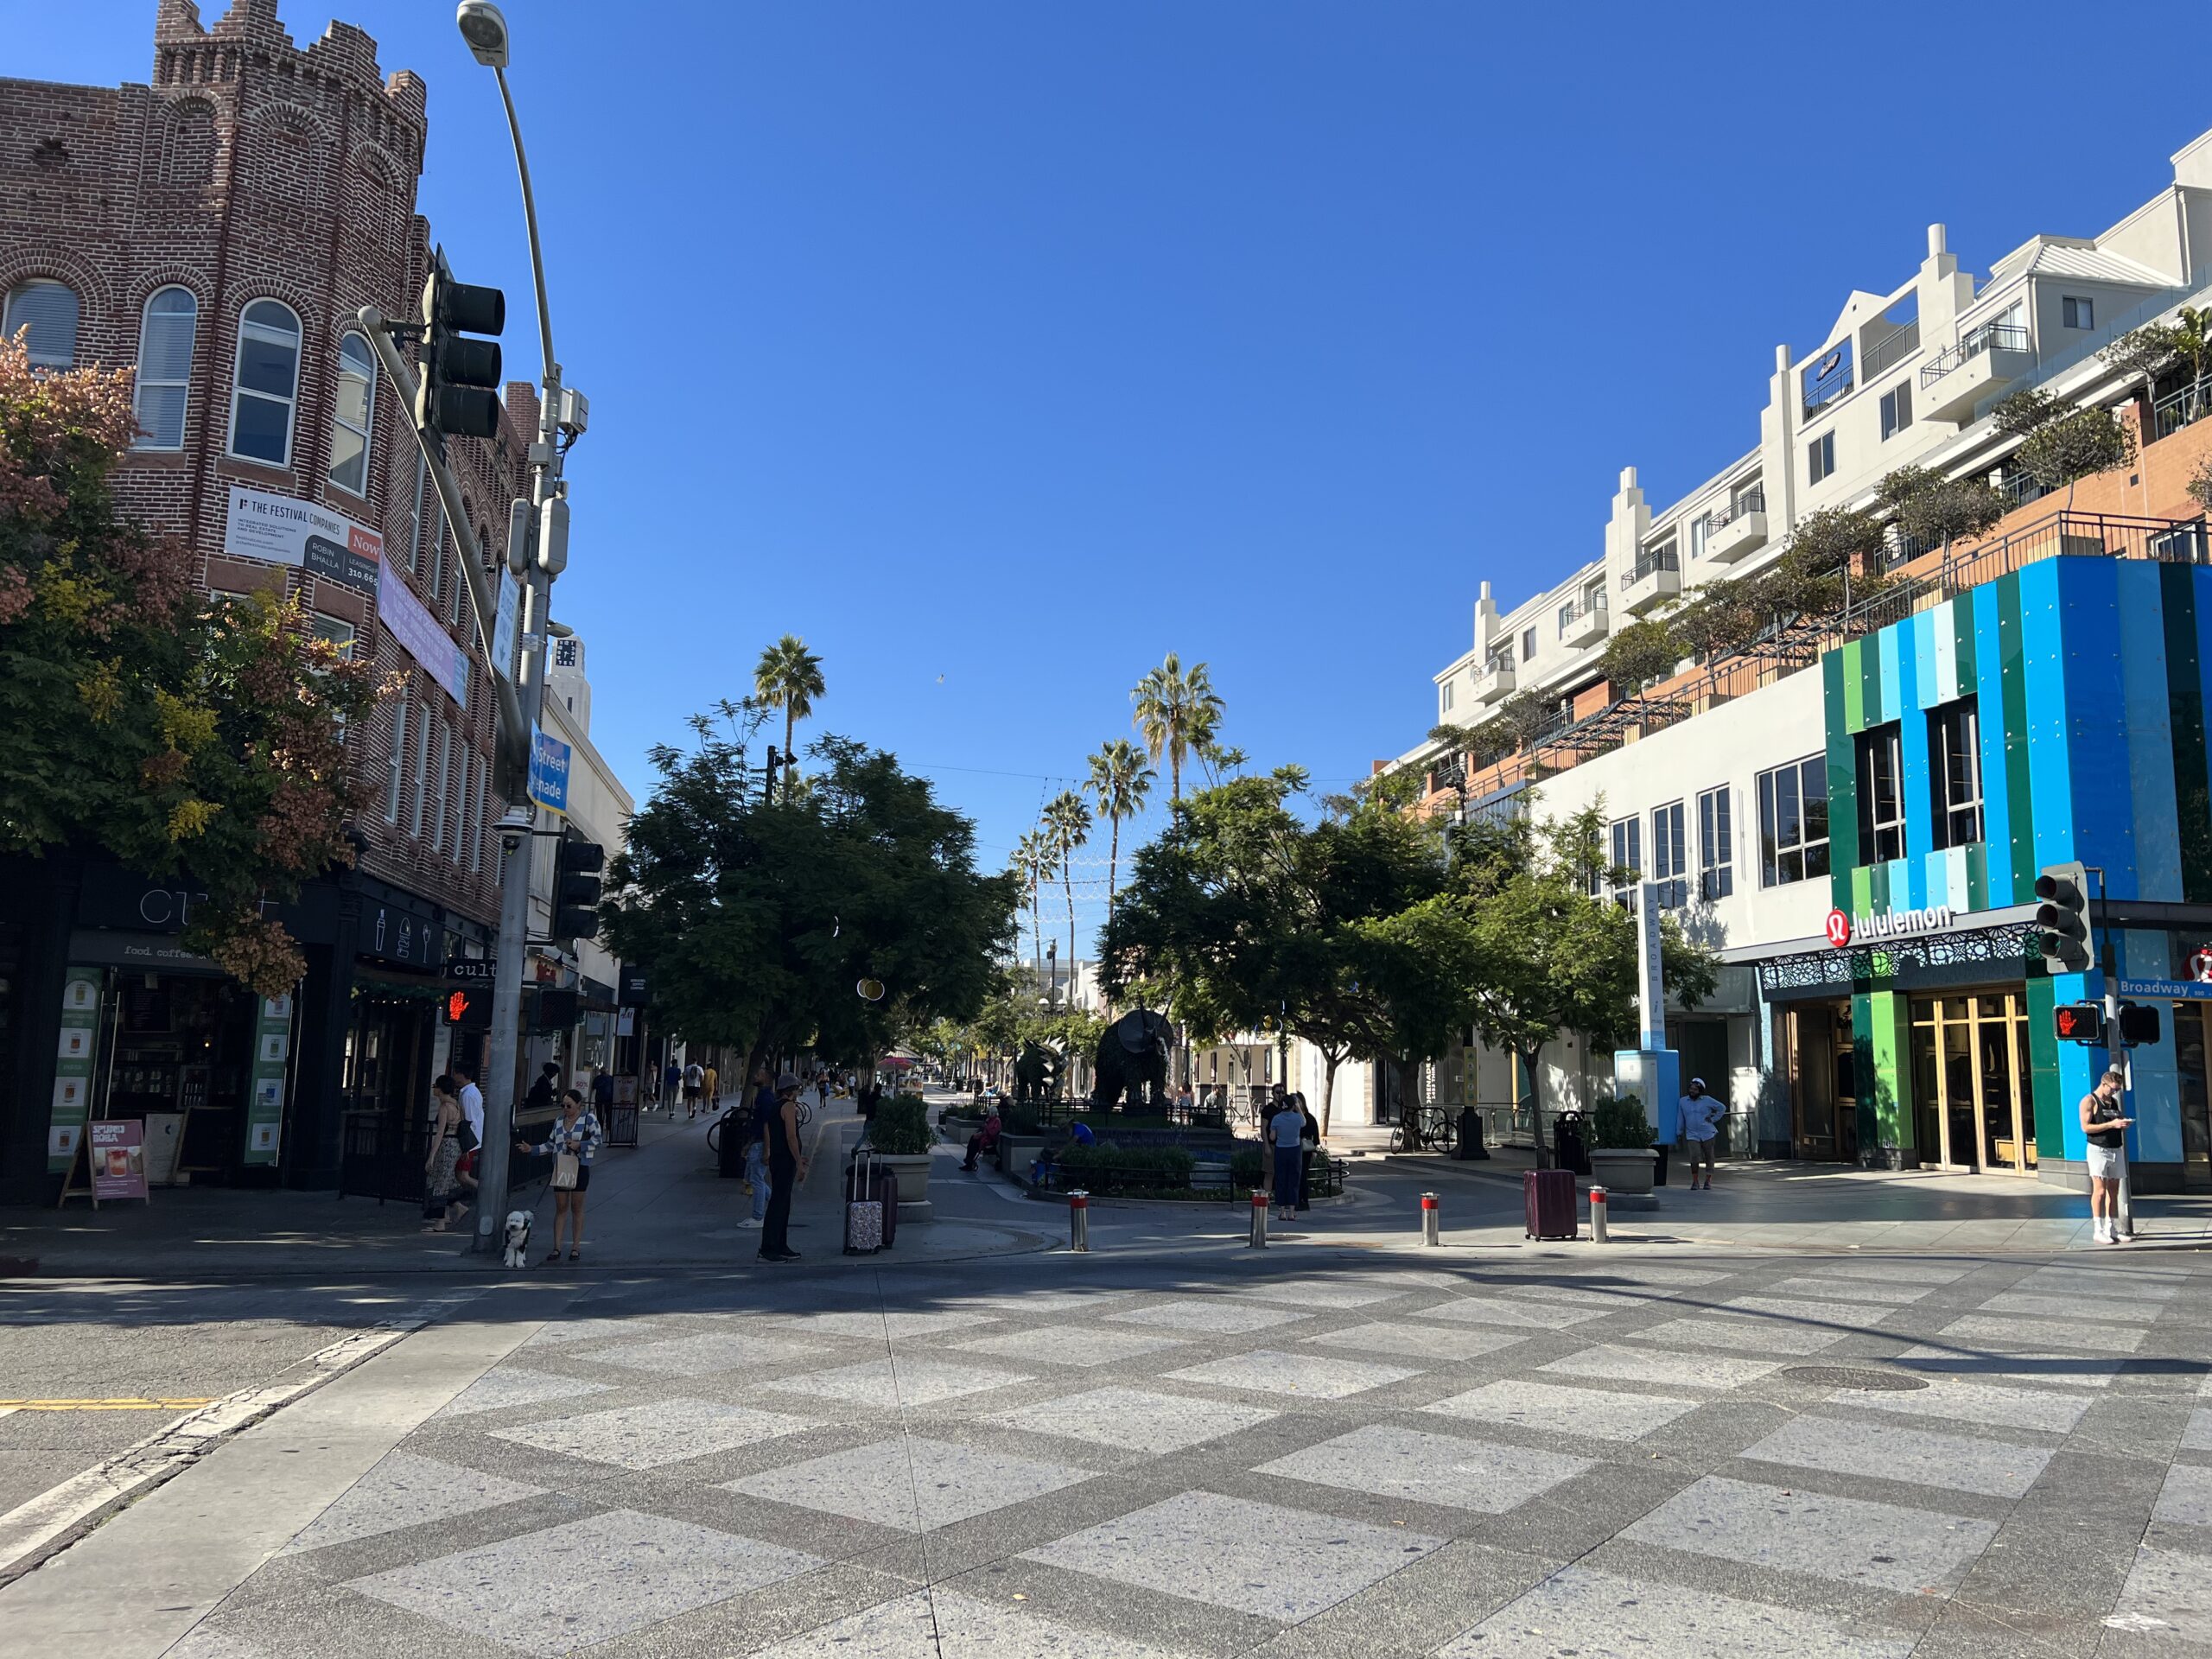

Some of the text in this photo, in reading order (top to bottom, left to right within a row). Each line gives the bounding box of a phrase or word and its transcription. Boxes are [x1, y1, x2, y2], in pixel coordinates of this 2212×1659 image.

[238, 518, 296, 533] INTEGRATED SOLUTIONS
[252, 501, 340, 536] THE FESTIVAL COMPANIES
[248, 529, 284, 538] DEVELOPMENT
[312, 543, 335, 557] ROBIN
[311, 552, 340, 570] BHALLA
[538, 747, 565, 773] Street
[1853, 905, 1951, 938] lululemon
[1648, 898, 1658, 982] BROADWAY
[124, 946, 152, 957] food
[454, 963, 497, 977] cult
[2120, 981, 2189, 997] Broadway
